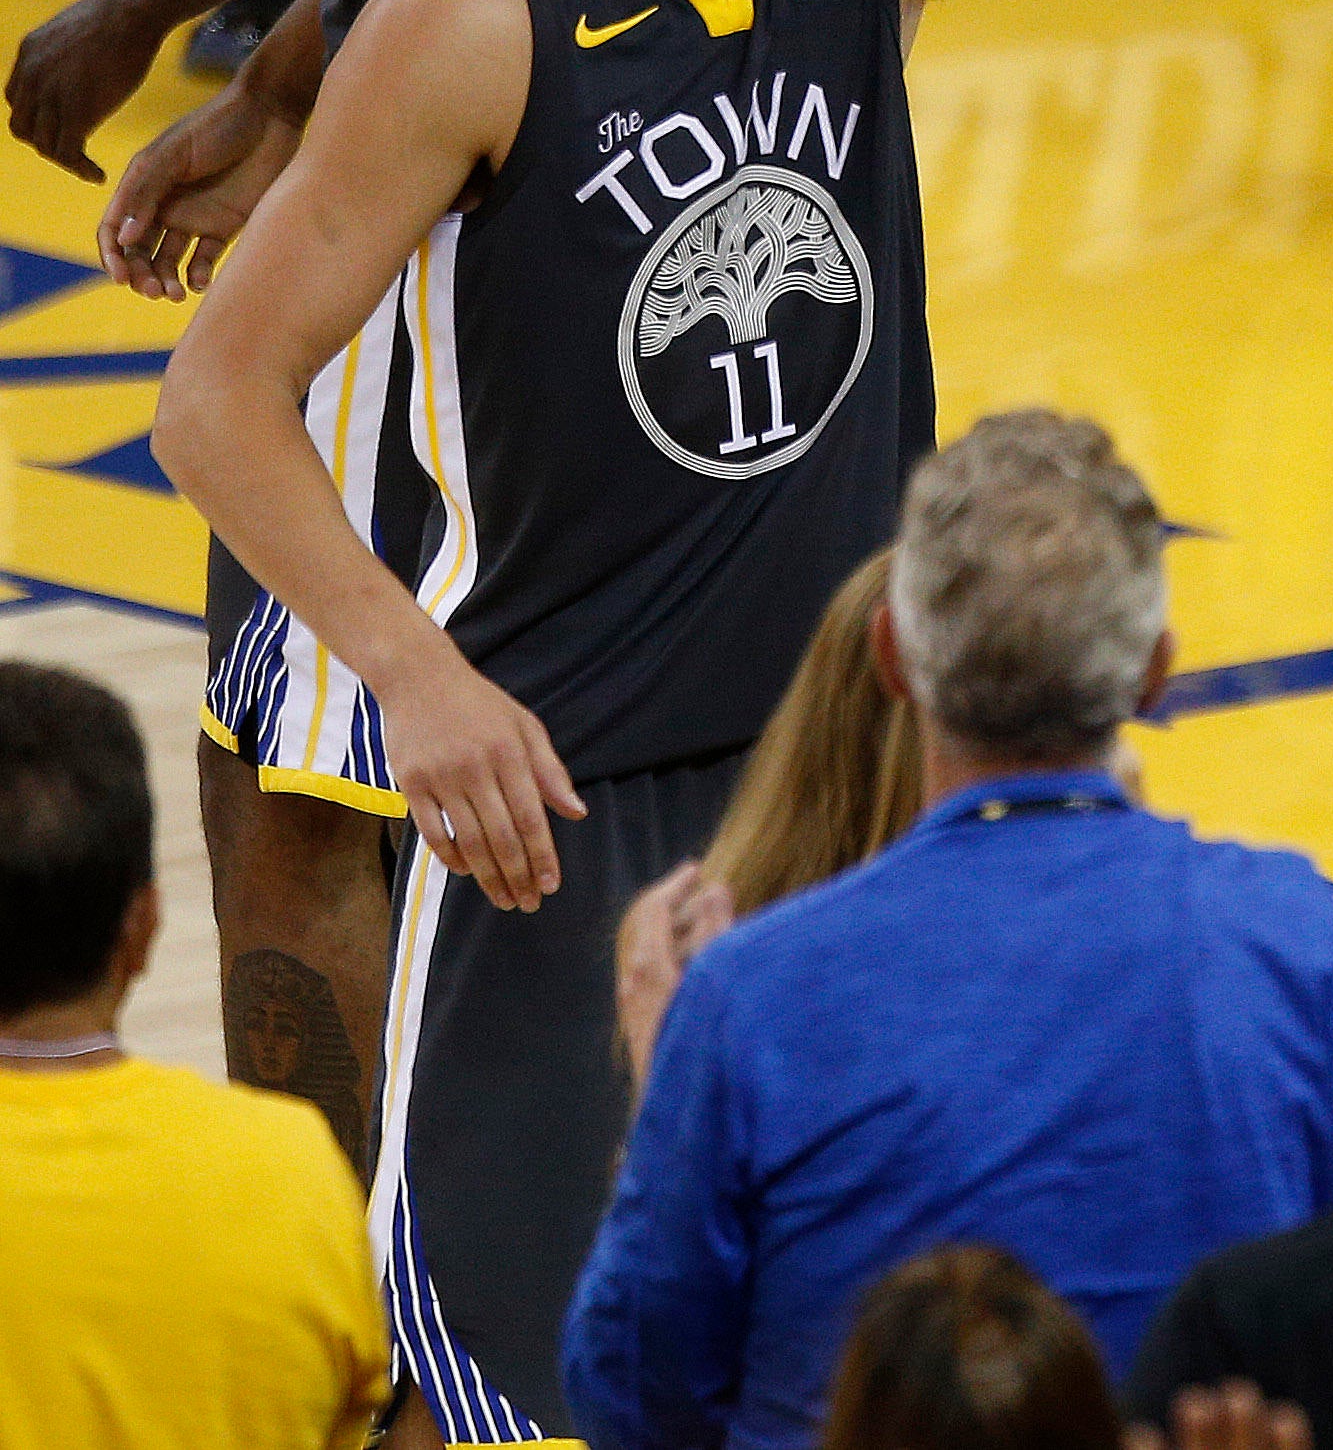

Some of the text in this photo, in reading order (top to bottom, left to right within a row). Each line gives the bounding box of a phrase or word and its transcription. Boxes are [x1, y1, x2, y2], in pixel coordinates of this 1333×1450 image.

[575, 70, 861, 235] TOWN
[598, 109, 643, 153] The
[709, 340, 797, 455] 11
